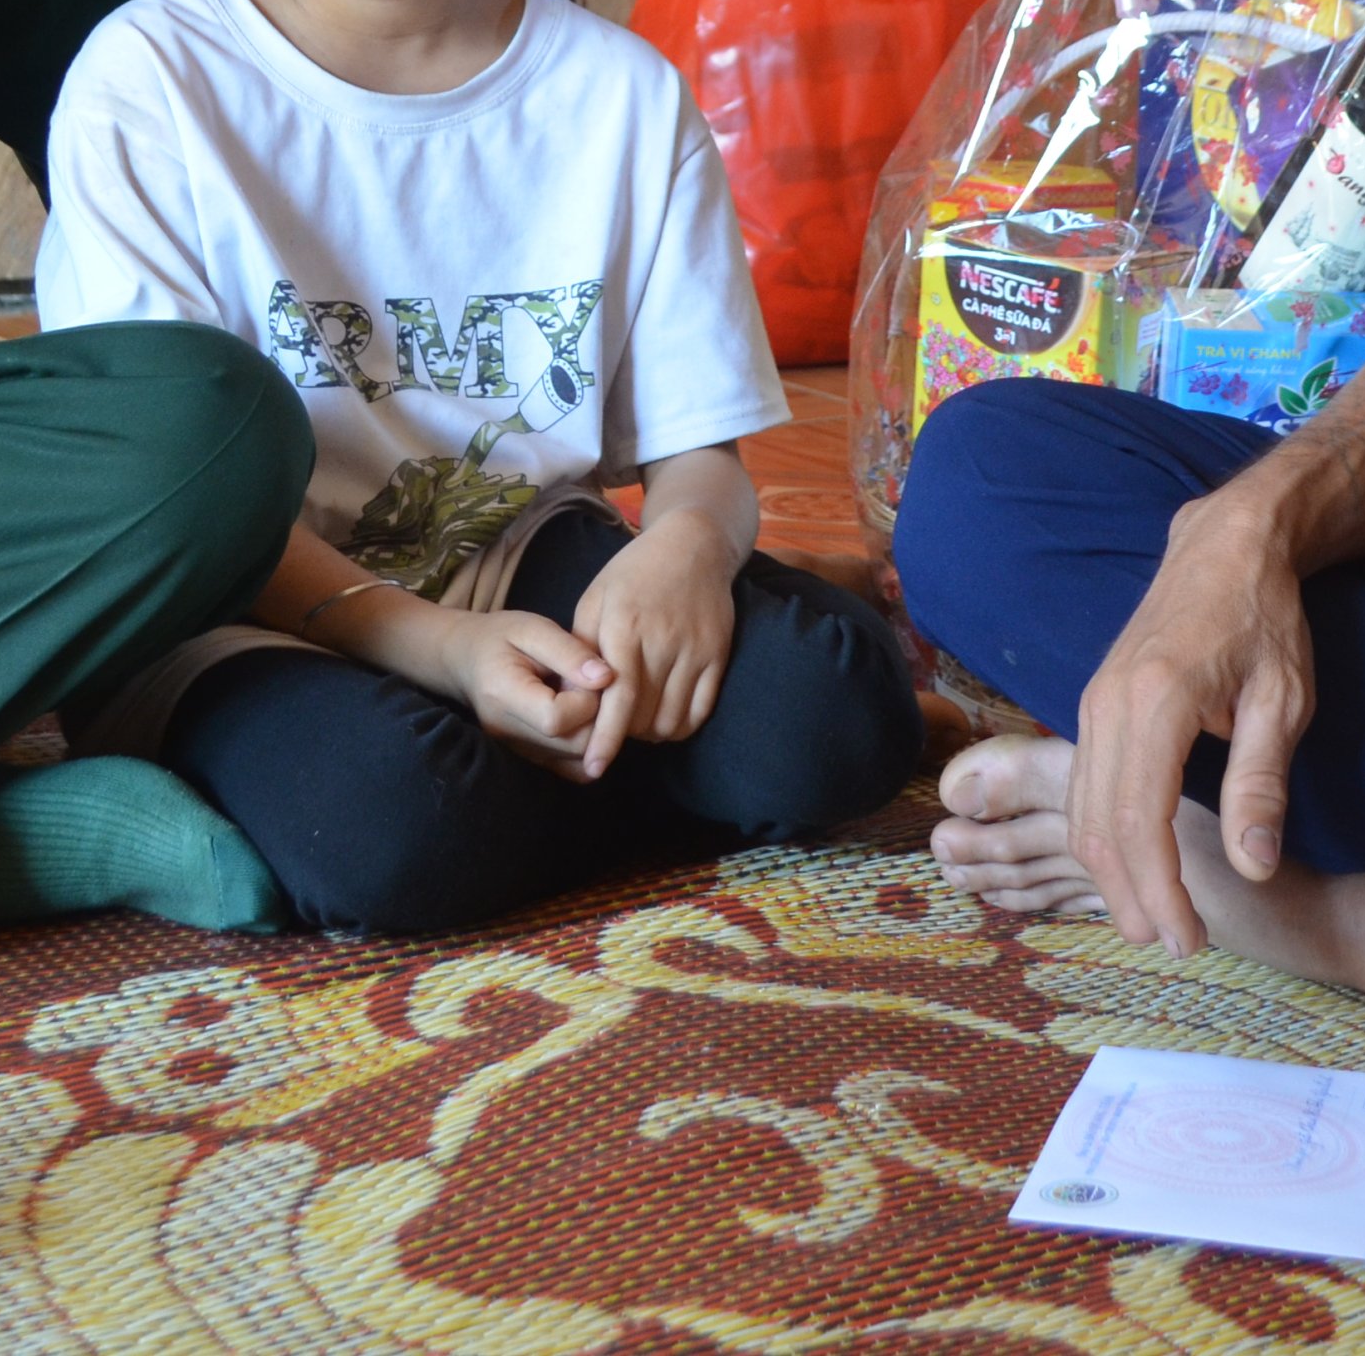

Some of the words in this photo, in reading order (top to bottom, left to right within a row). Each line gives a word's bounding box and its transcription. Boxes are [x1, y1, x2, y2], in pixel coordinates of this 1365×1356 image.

[959, 260, 1059, 314] NESCAFÉ
[981, 302, 1005, 322] PHÊ
[269, 278, 604, 403] ARMY
